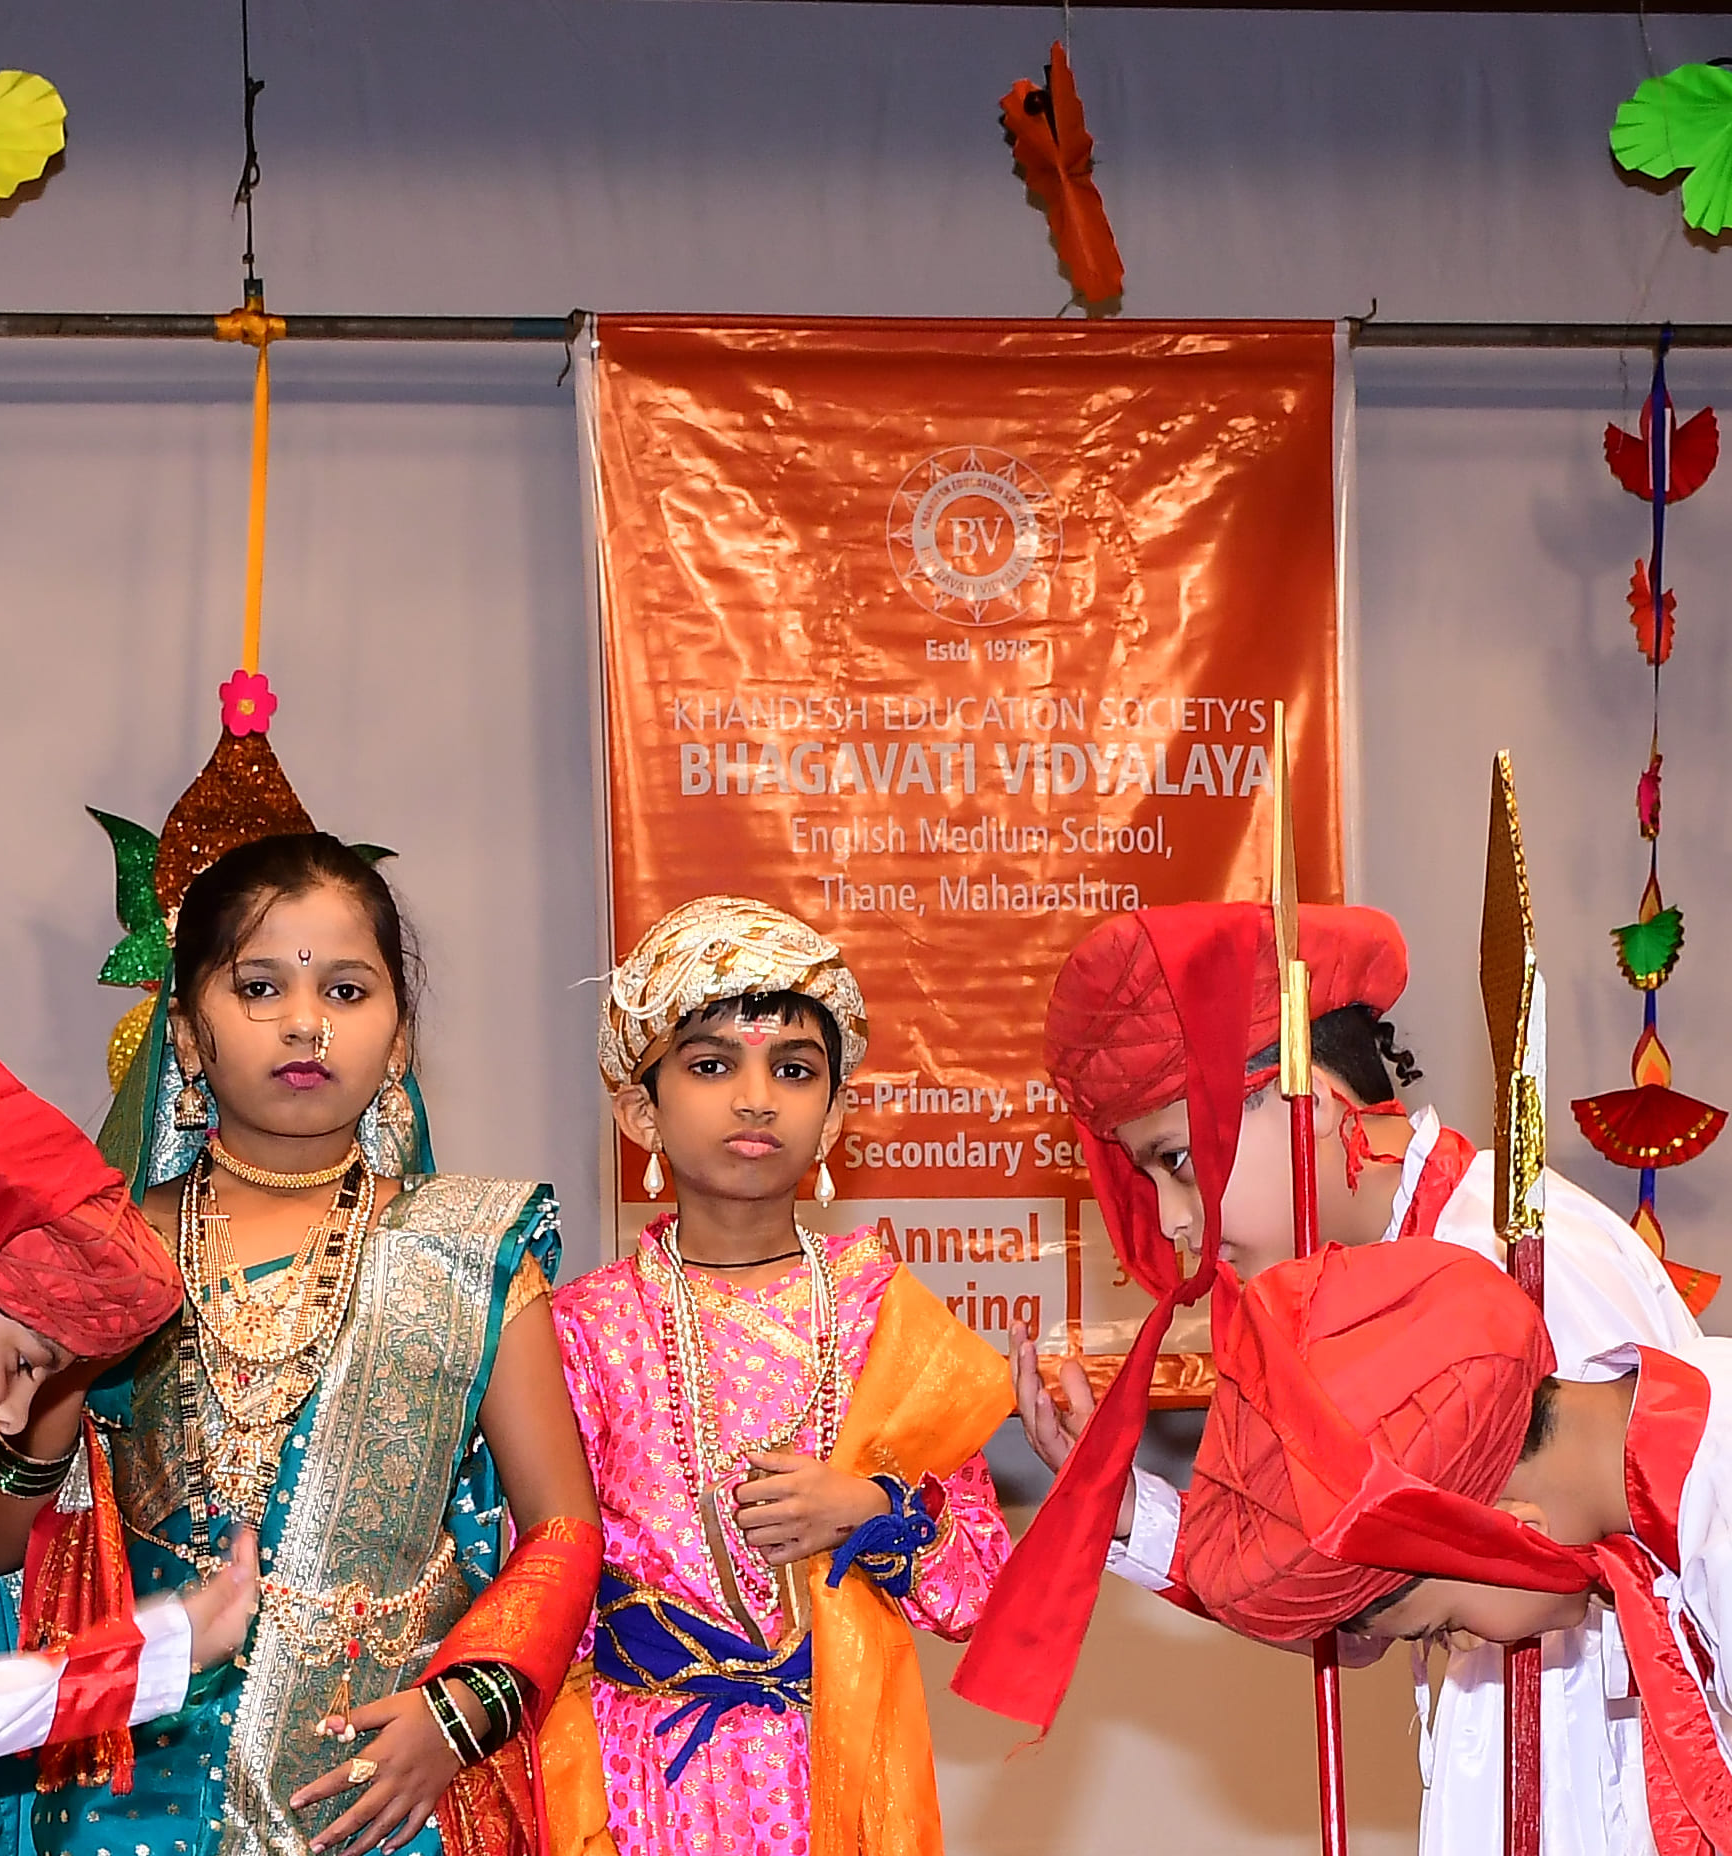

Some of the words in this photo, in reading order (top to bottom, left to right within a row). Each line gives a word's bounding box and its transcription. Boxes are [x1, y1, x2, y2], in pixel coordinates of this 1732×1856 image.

[950, 516, 1004, 557] BV
[984, 639, 1030, 661] 1978
[674, 697, 867, 730] KHANDESH
[883, 697, 1084, 730] EDUCATION
[1099, 697, 1267, 734] SOCIETY'S
[680, 741, 975, 795] BHAGAVATI
[994, 742, 1274, 797] VIDYALAYA
[791, 816, 906, 863] English
[919, 816, 1050, 855] Medium
[1061, 816, 1173, 859] School,
[818, 874, 926, 917] Thane,
[940, 873, 1150, 913] Maharashtra.
[844, 1079, 1013, 1123] e-Primary,
[845, 1132, 1023, 1177] Secondary
[876, 1212, 1041, 1263] Annual
